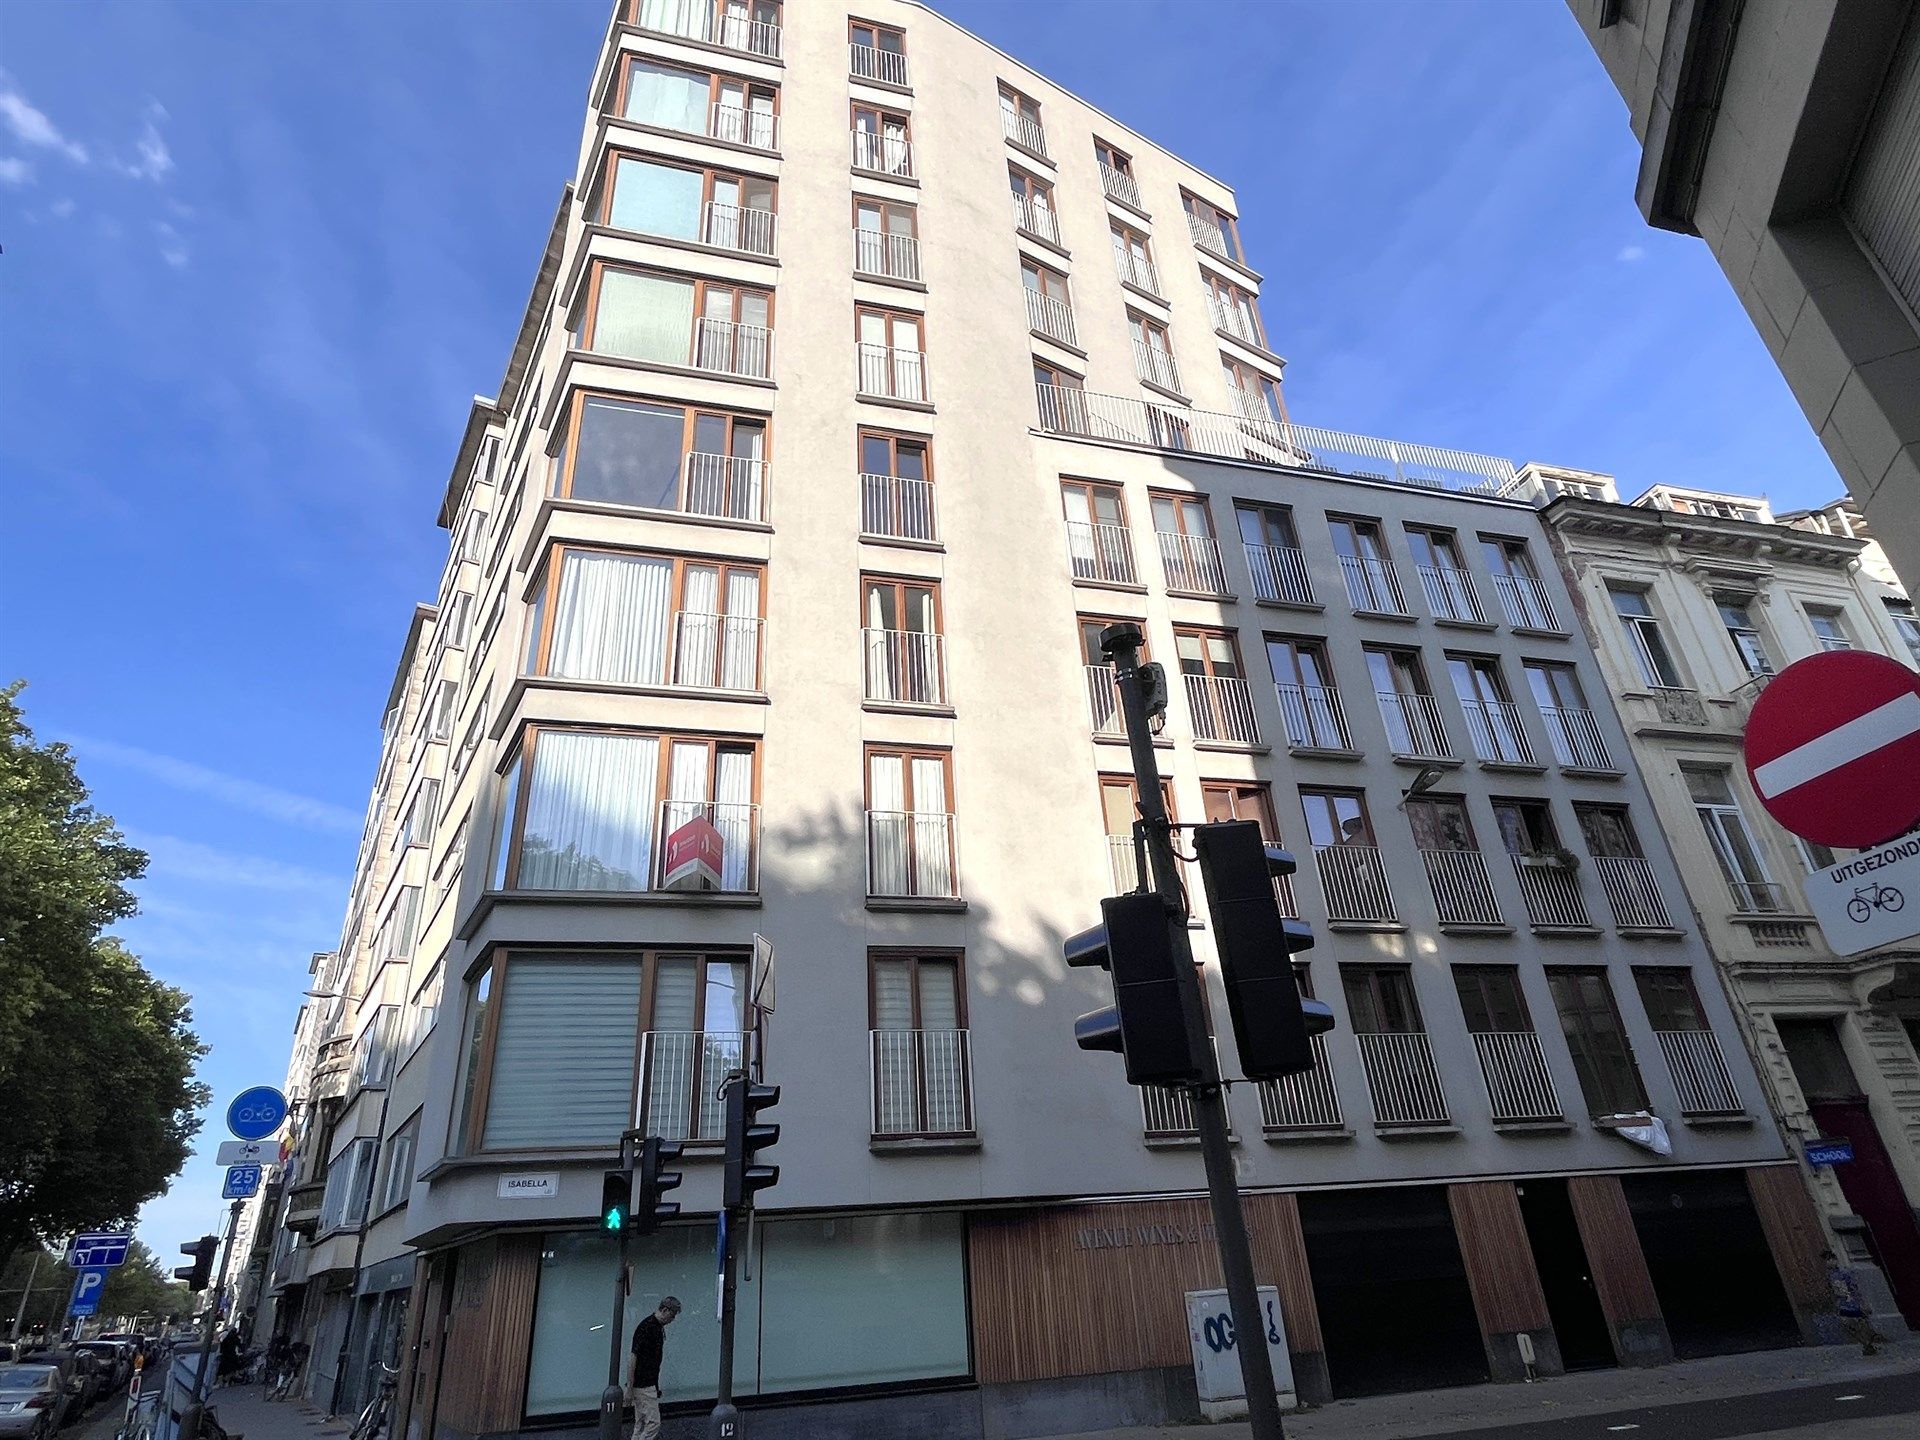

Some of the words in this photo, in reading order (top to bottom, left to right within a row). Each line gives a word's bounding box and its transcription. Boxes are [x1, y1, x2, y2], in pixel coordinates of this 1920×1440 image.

[1831, 838, 1920, 884] UITGEZOND
[232, 1171, 254, 1184] 25
[508, 1180, 548, 1188] ISABELLA
[1075, 1227, 1133, 1250] AVENUE
[1136, 1223, 1184, 1246] WINES
[1187, 1224, 1198, 1245] &
[78, 1273, 102, 1298] P
[606, 1402, 615, 1413] 11
[721, 1422, 734, 1437] 12
